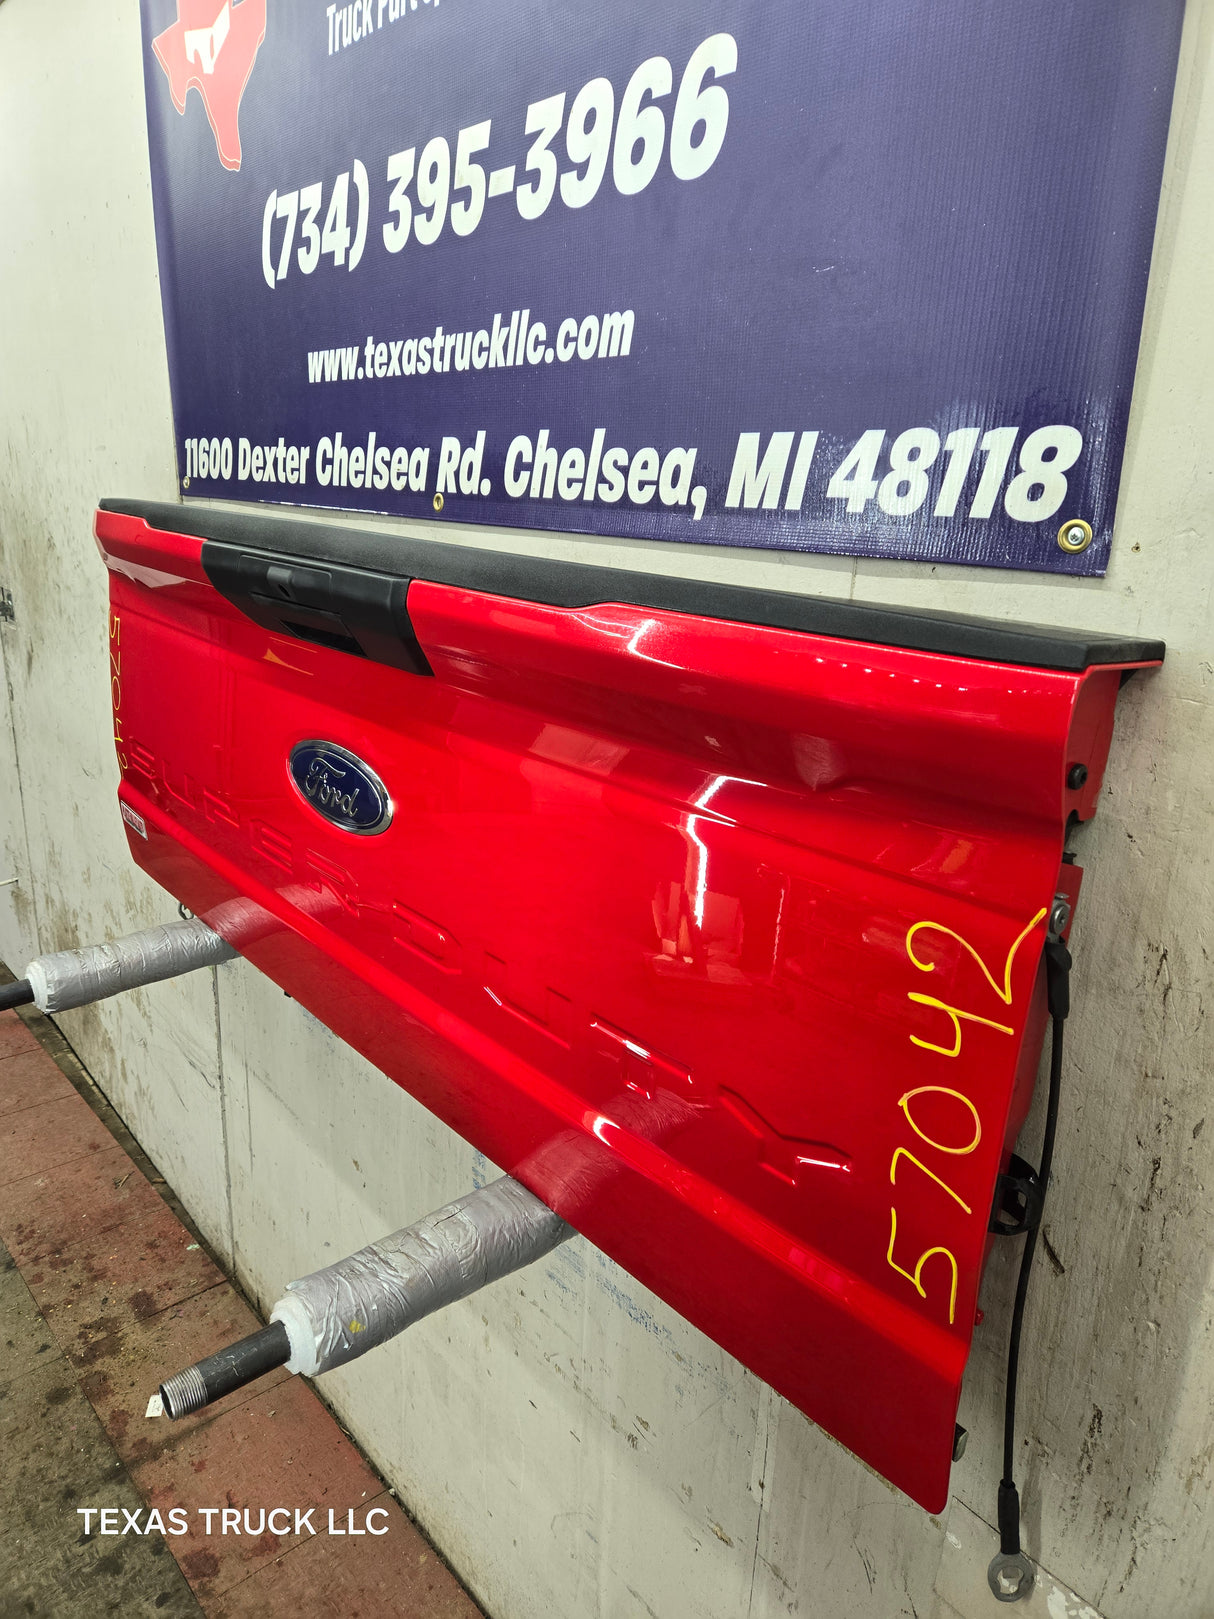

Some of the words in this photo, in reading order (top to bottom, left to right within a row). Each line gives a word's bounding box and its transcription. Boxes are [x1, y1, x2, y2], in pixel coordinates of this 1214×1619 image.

[326, 0, 374, 56] Truck
[261, 158, 370, 290] (734)
[382, 32, 738, 254] 395-3966
[307, 308, 635, 383] www.texastruckllc.com
[184, 437, 233, 480] 11600
[237, 437, 310, 484] Dexter
[315, 431, 430, 492] Chelsea
[435, 430, 491, 496] Rd.
[504, 427, 708, 521] Chelsea,
[724, 431, 820, 511] MI
[825, 424, 1083, 523] 48118
[304, 757, 361, 818] Ford
[886, 907, 1048, 1325] 57042
